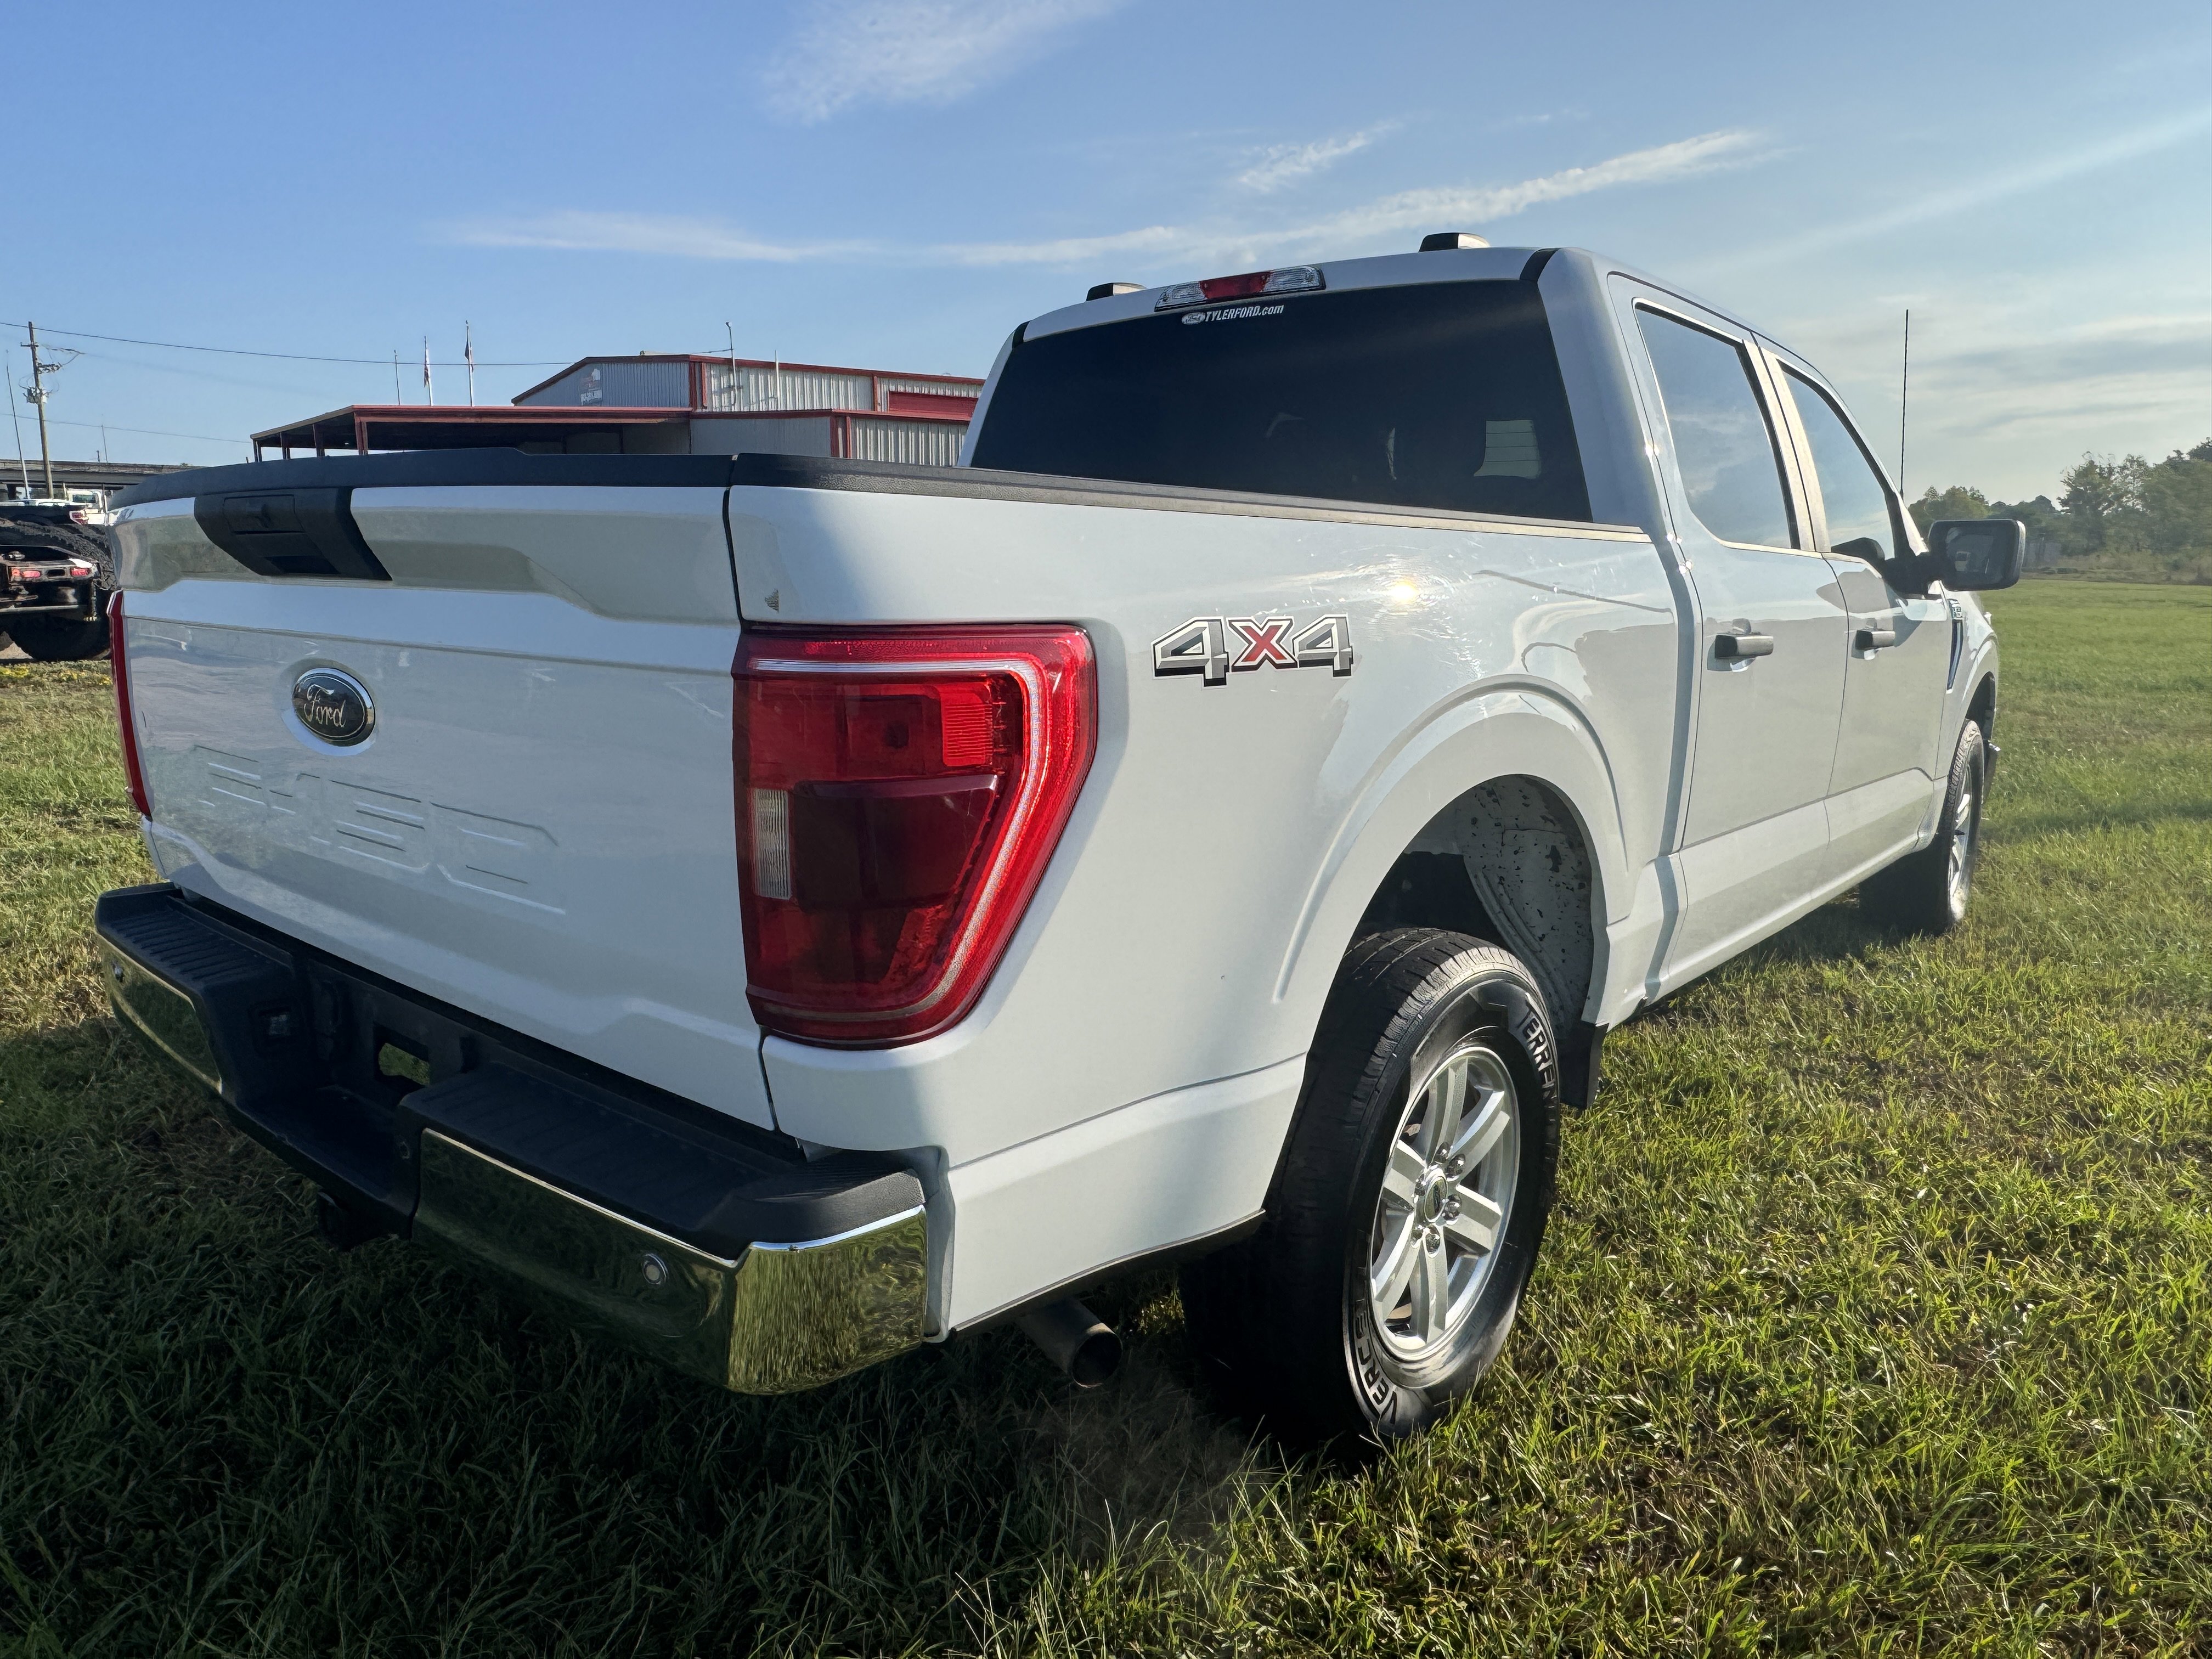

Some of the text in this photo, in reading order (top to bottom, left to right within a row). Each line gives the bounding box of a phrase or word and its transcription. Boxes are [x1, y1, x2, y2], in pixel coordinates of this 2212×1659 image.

[1205, 305, 1285, 322] TYLERFORD.com
[303, 684, 347, 729] Ford
[1515, 999, 1558, 1121] TERREN
